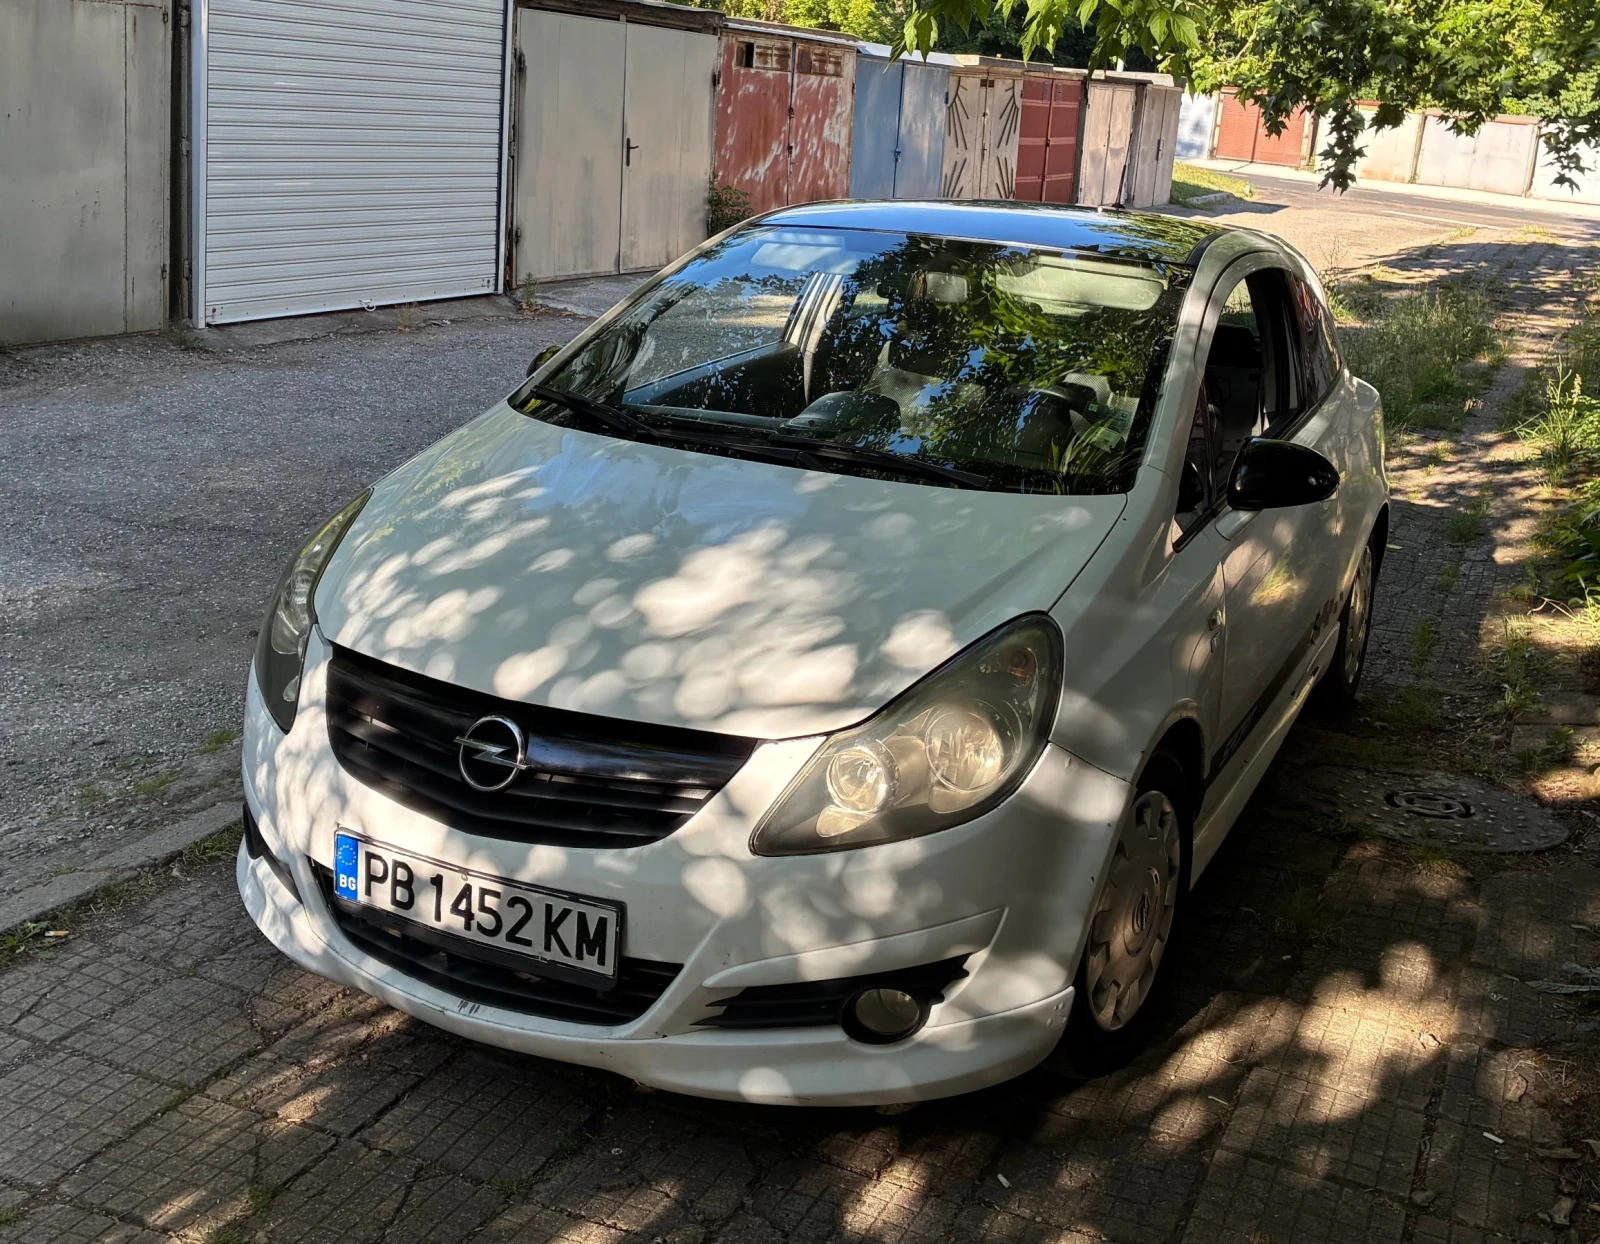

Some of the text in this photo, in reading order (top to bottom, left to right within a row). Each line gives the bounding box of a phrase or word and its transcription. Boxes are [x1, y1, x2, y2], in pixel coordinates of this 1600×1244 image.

[339, 873, 357, 891] BG
[364, 850, 608, 967] PB 1452 KM
